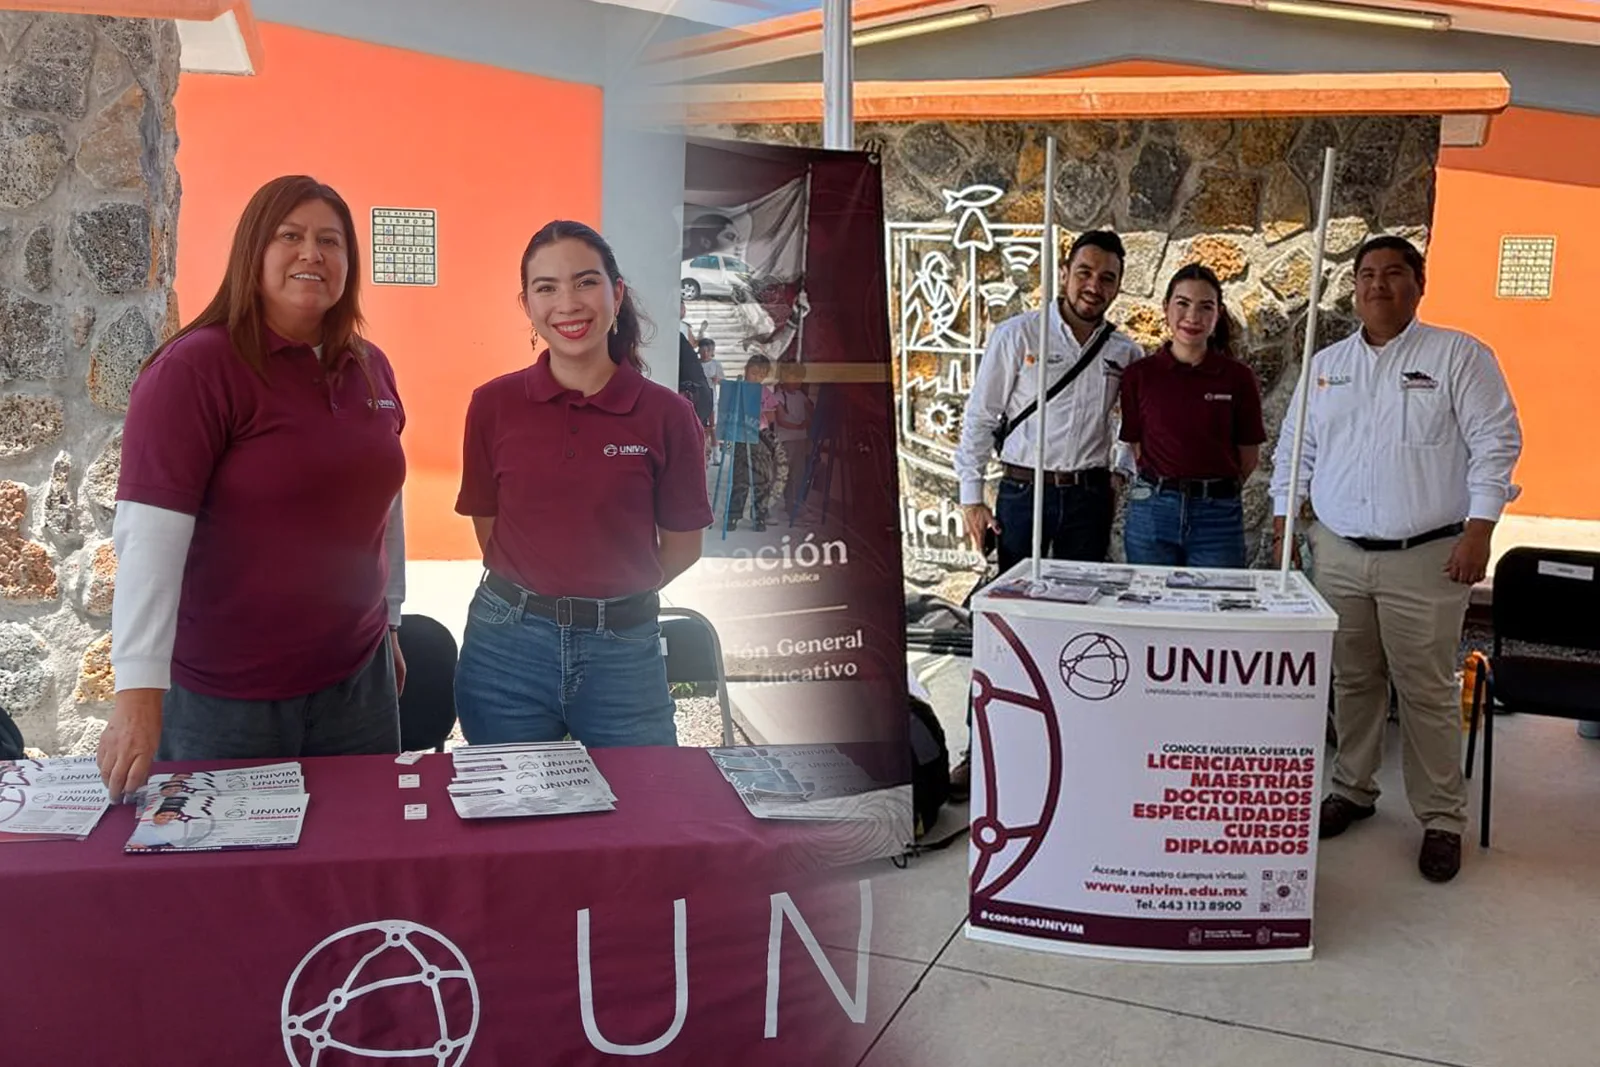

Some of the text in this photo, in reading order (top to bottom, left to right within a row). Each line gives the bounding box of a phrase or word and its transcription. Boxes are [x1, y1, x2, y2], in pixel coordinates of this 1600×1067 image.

[781, 570, 821, 584] Pública
[776, 629, 864, 657] General
[1146, 645, 1316, 687] UNIVIM
[1162, 744, 1313, 756] CONOCE NUESTRA OFERTA EN
[1147, 754, 1315, 772] LICENCIATURAS
[250, 770, 297, 780] UNIVIM
[1190, 771, 1314, 789] MAESTRÍAS
[540, 778, 591, 790] UNIVIM
[57, 795, 107, 803] UNIVIM
[1163, 789, 1312, 805] DOCTORADOS
[250, 807, 301, 815] UNIVIM
[1132, 803, 1312, 822] ESPECIALIDADES
[1223, 824, 1310, 838] CURSOS
[1164, 838, 1309, 855] DIPLOMADOS
[1092, 865, 1129, 876] Accede
[1130, 869, 1136, 877] a
[1138, 869, 1174, 879] nuestro
[1176, 870, 1213, 881] campus
[1084, 880, 1249, 897] www.univim.edu.mx
[1136, 900, 1242, 911] Tel. 443 113 8900
[980, 910, 1085, 935] #conectaUNIVIM
[577, 879, 873, 1056] UN
